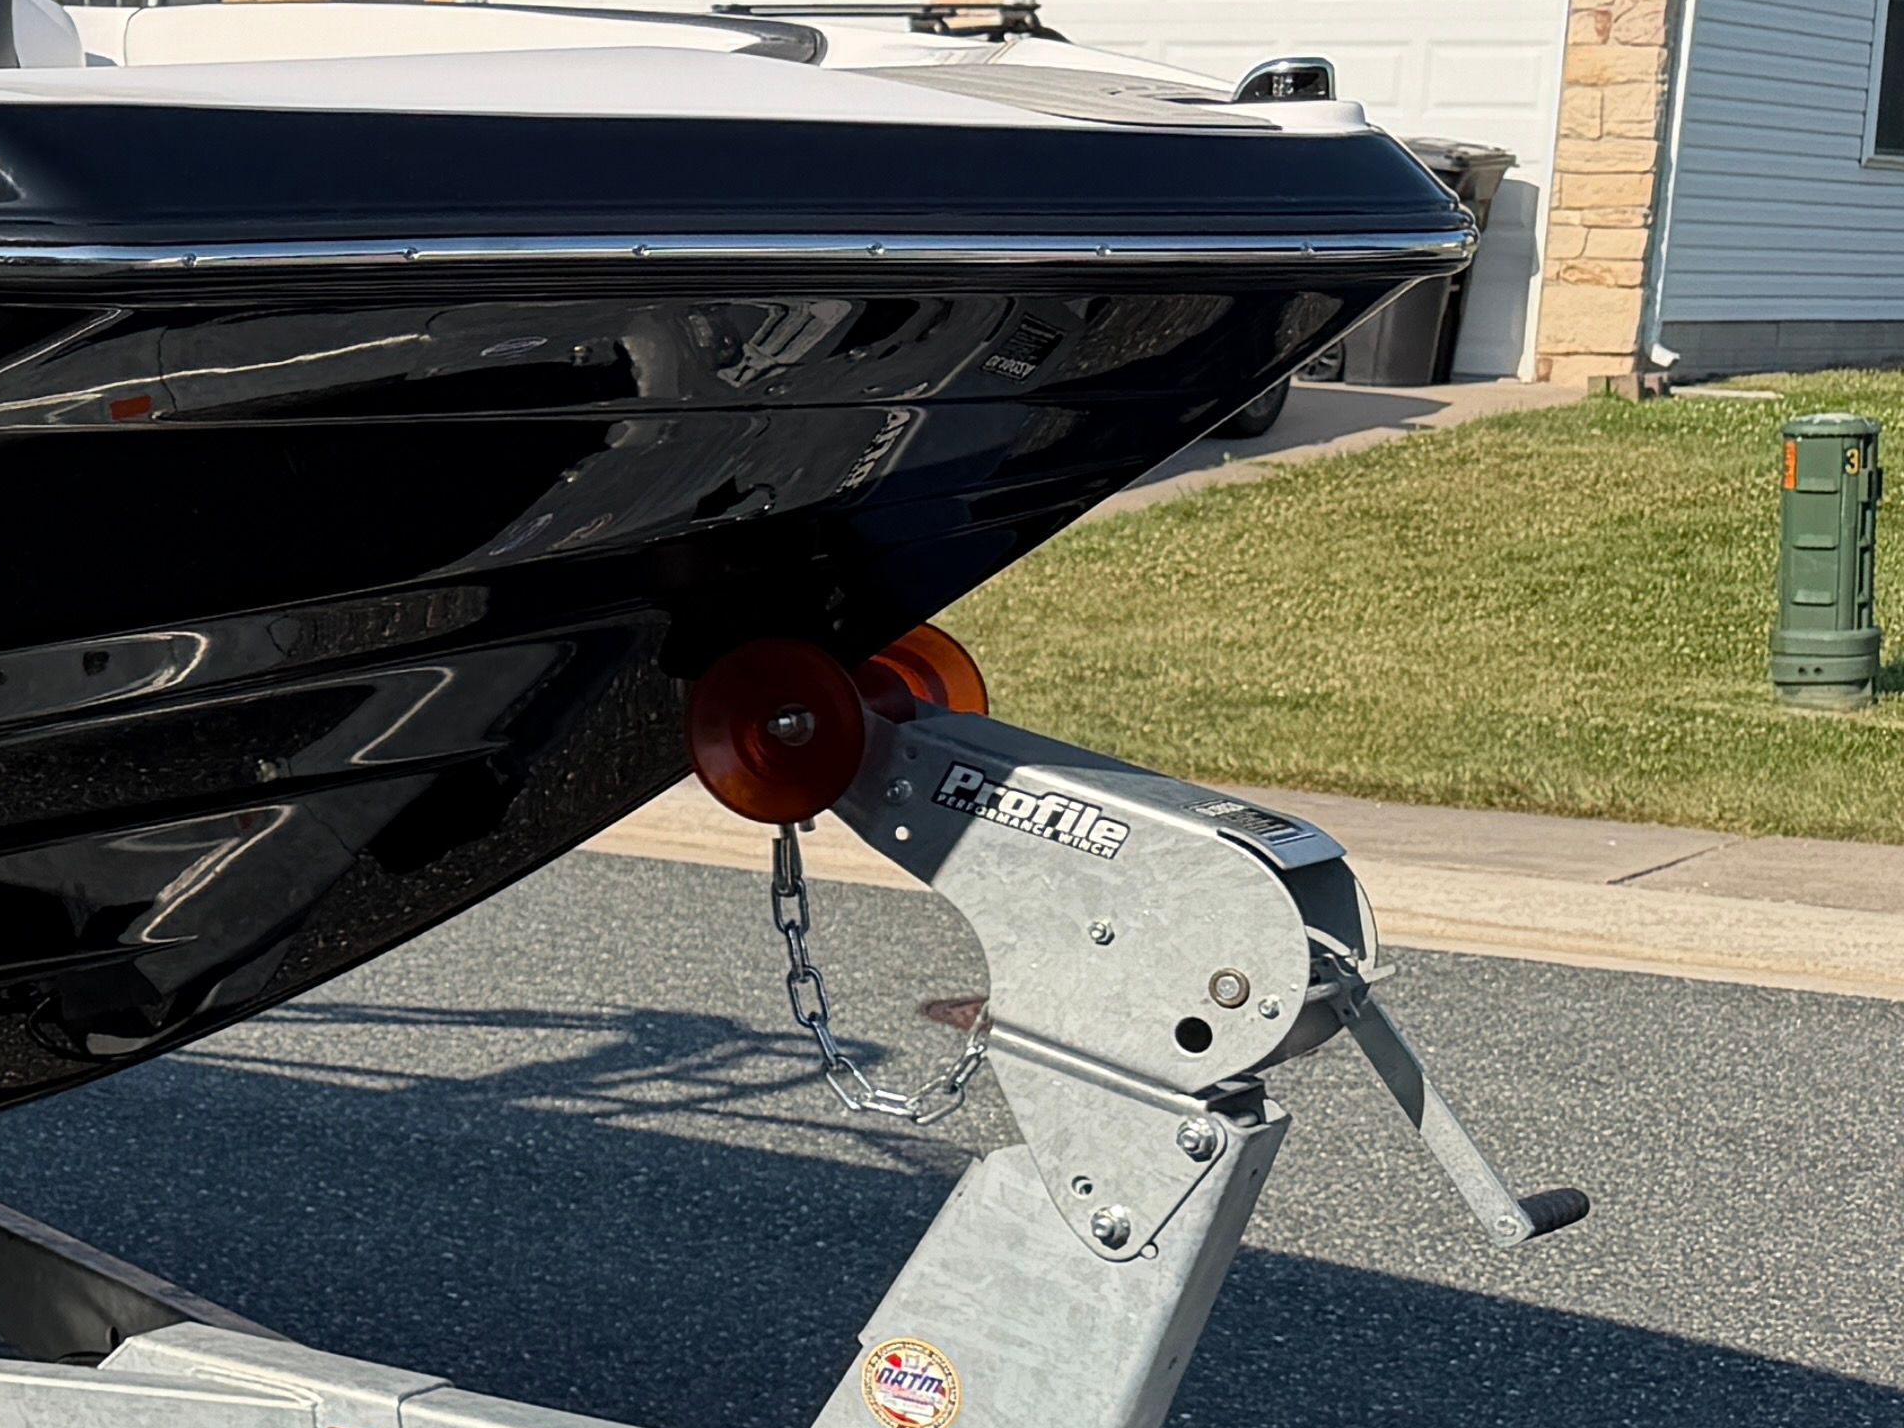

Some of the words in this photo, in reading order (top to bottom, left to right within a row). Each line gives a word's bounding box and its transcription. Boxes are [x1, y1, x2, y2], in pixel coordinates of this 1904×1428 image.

[1845, 448, 1859, 476] 3
[936, 793, 1054, 839] PERFORMANCE
[1057, 831, 1116, 860] WINCH
[940, 764, 1130, 850] Profile
